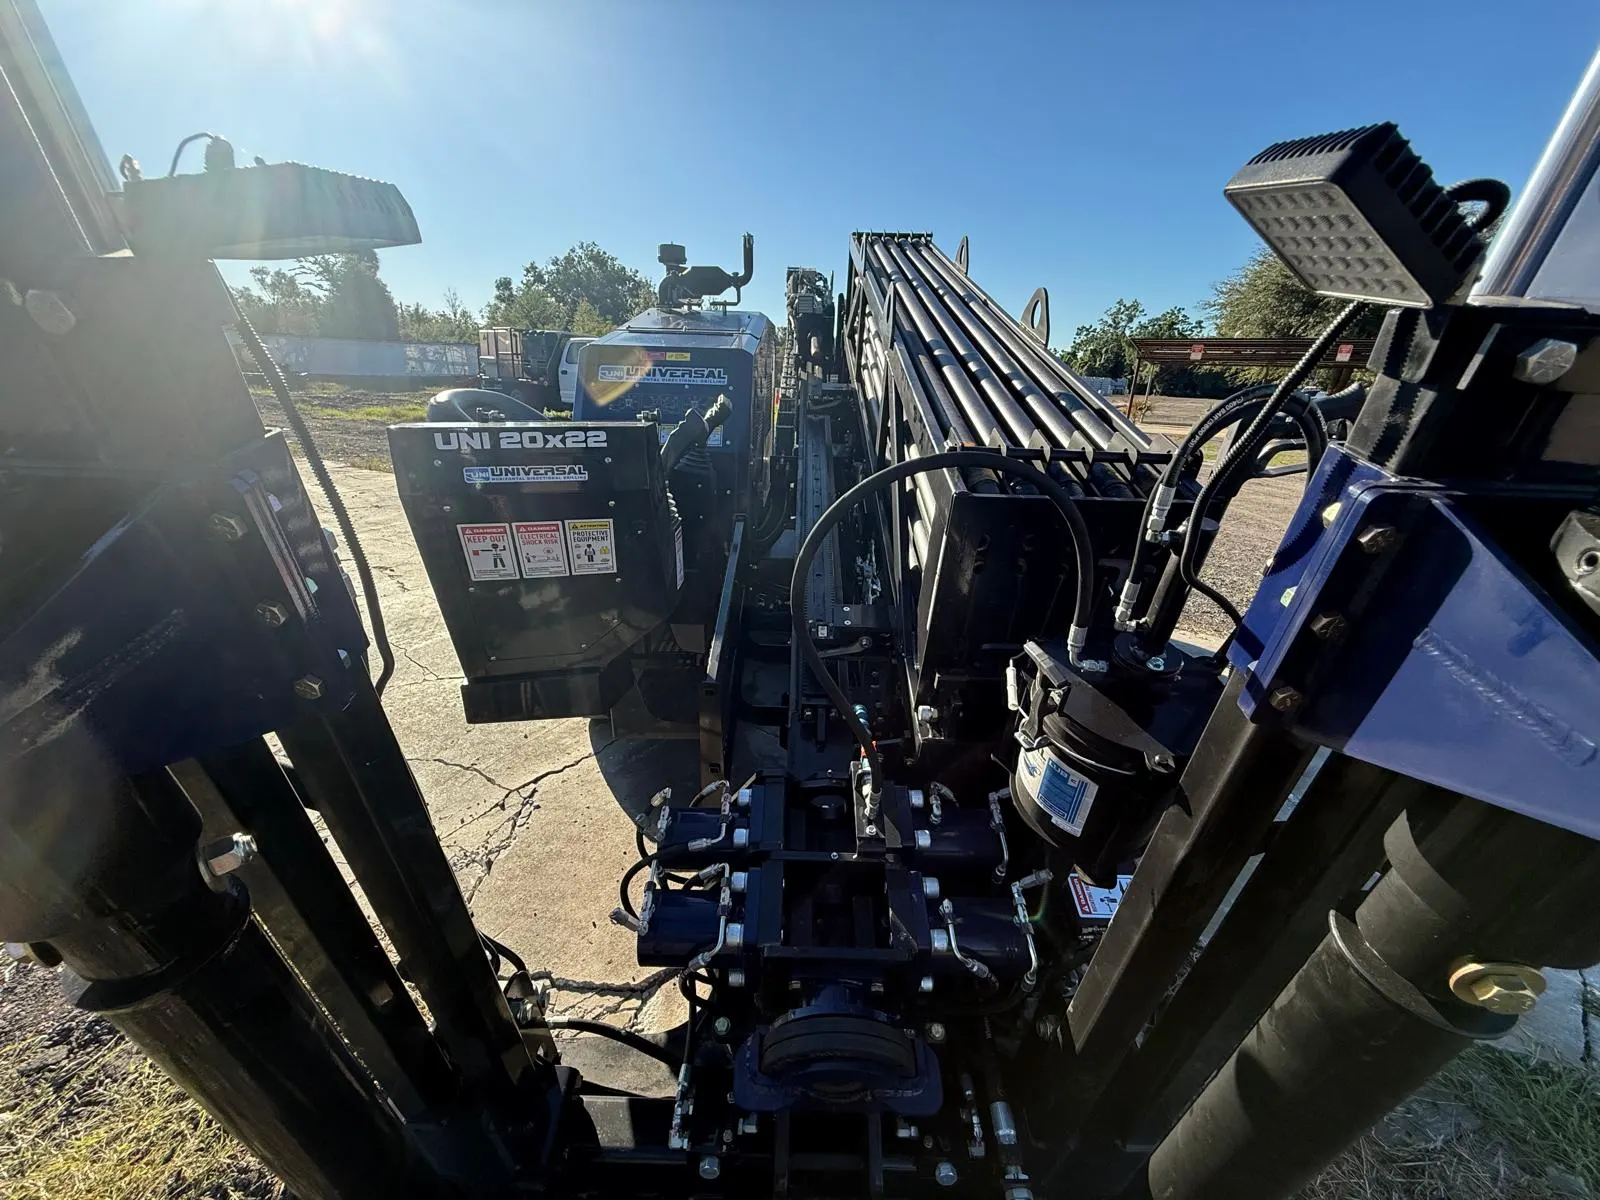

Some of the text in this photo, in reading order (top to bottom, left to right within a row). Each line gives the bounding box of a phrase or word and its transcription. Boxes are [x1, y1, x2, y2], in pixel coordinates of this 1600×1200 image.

[606, 370, 624, 378] UNI
[625, 366, 727, 379] UNIVERSAL
[434, 431, 608, 450] UNI 20x22
[490, 466, 586, 476] UNIVERSAL
[466, 535, 487, 543] KEEP
[520, 532, 558, 540] ELECTRICAL
